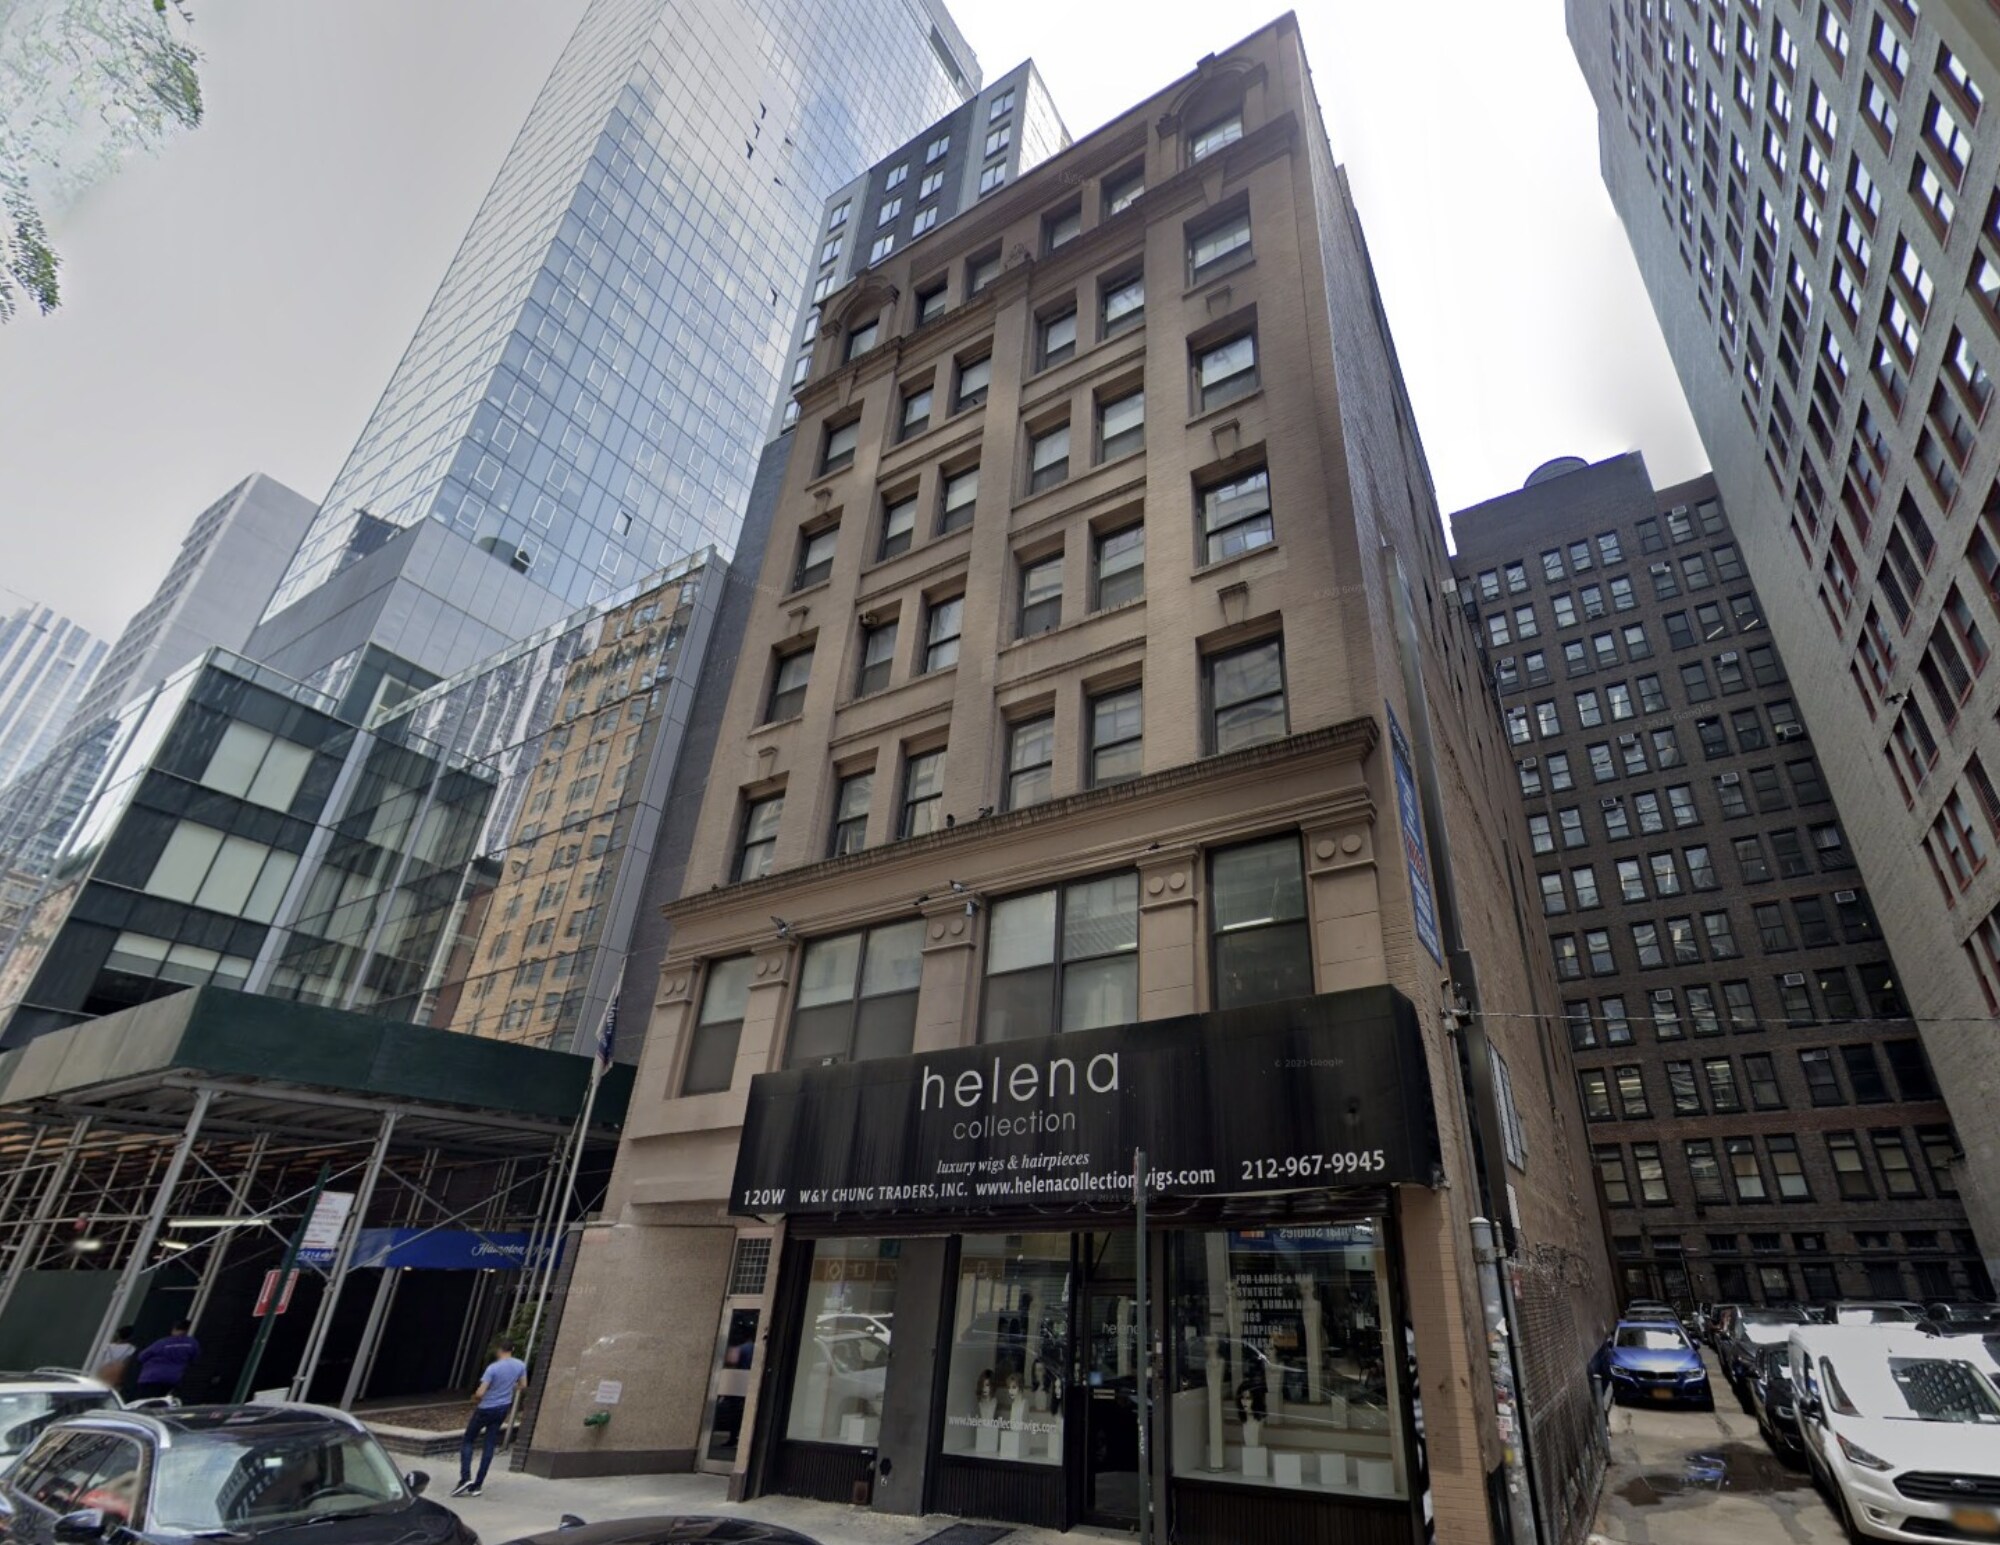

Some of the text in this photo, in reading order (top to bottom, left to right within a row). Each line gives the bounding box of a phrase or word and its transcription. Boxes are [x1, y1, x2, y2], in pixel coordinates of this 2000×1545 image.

[921, 1052, 1119, 1111] helena
[952, 1110, 1076, 1140] collection
[743, 1189, 786, 1206] 120W
[800, 1189, 829, 1204] W&Y
[831, 1186, 874, 1203] CHUNG
[1241, 1149, 1386, 1181] 212-967-9945
[936, 1151, 1090, 1176] luxury wigs & hairpieces
